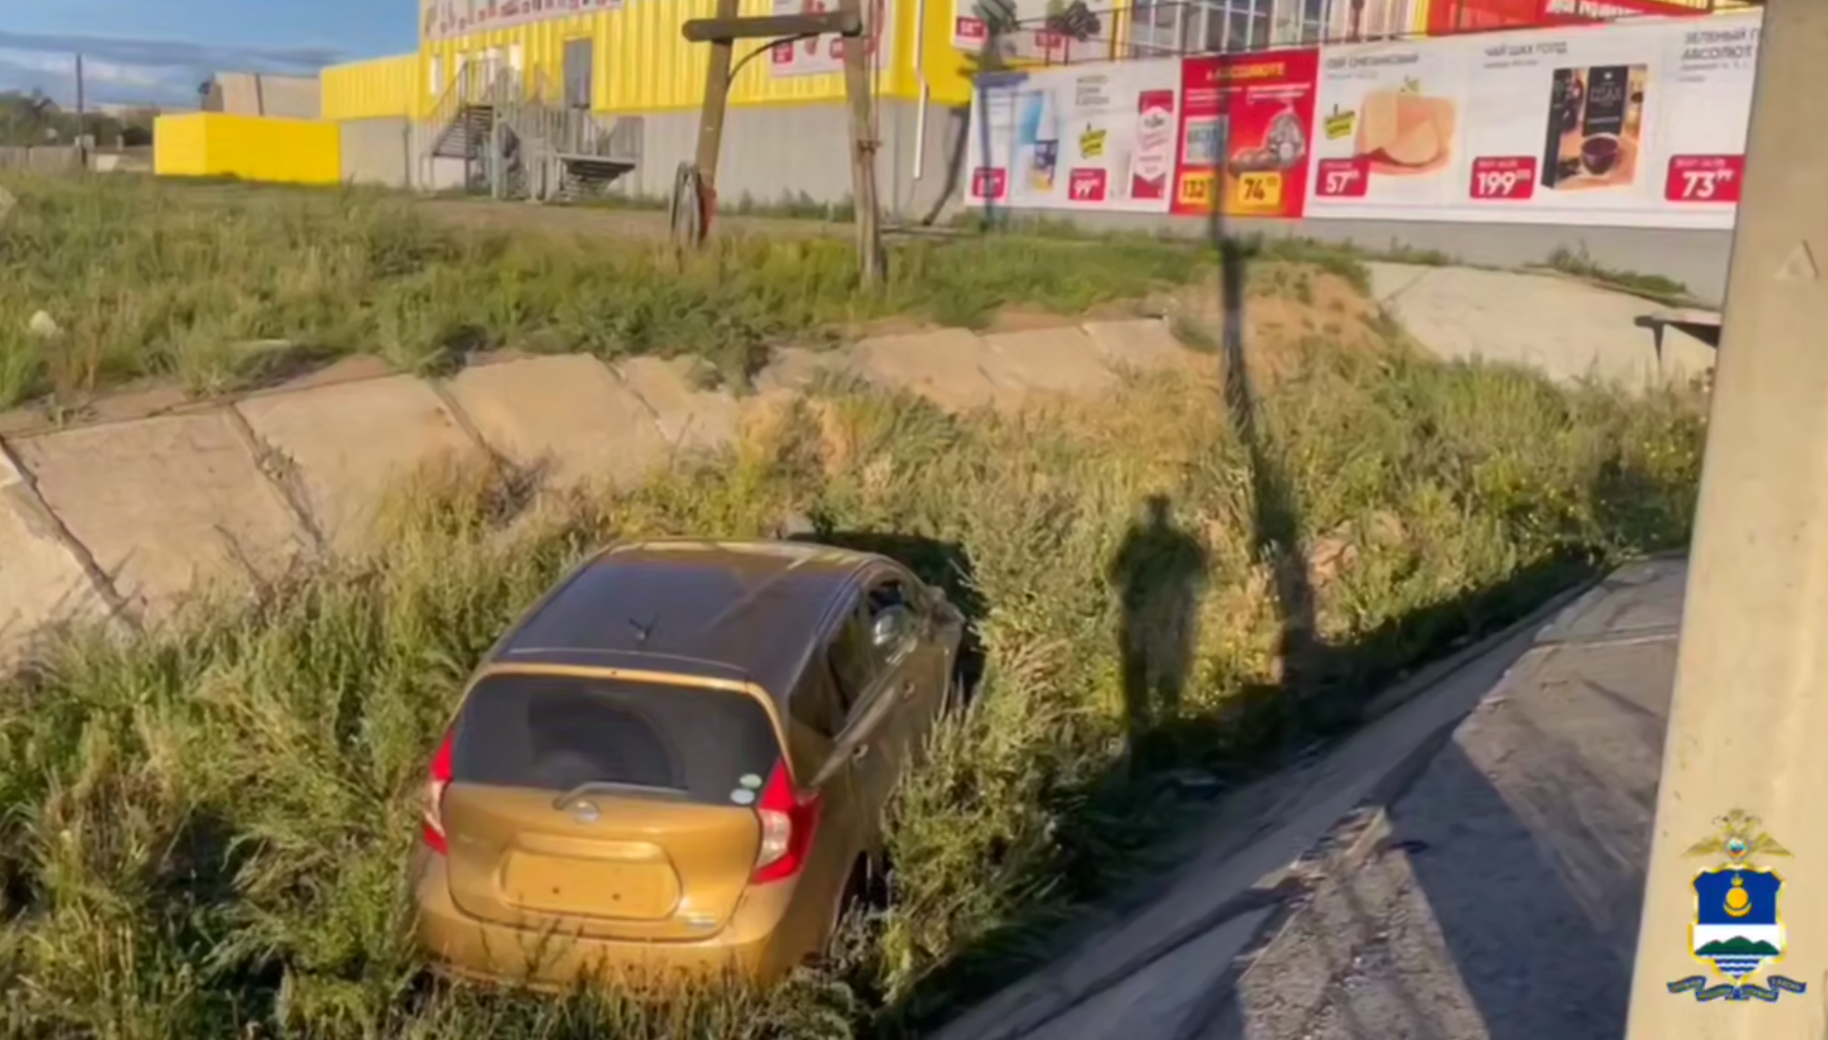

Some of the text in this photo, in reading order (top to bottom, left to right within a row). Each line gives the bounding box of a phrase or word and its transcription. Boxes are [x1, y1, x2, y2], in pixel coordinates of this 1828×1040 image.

[1244, 178, 1265, 200] 74
[1326, 171, 1349, 193] 57
[1477, 171, 1515, 195] 199
[1682, 171, 1714, 198] 73
